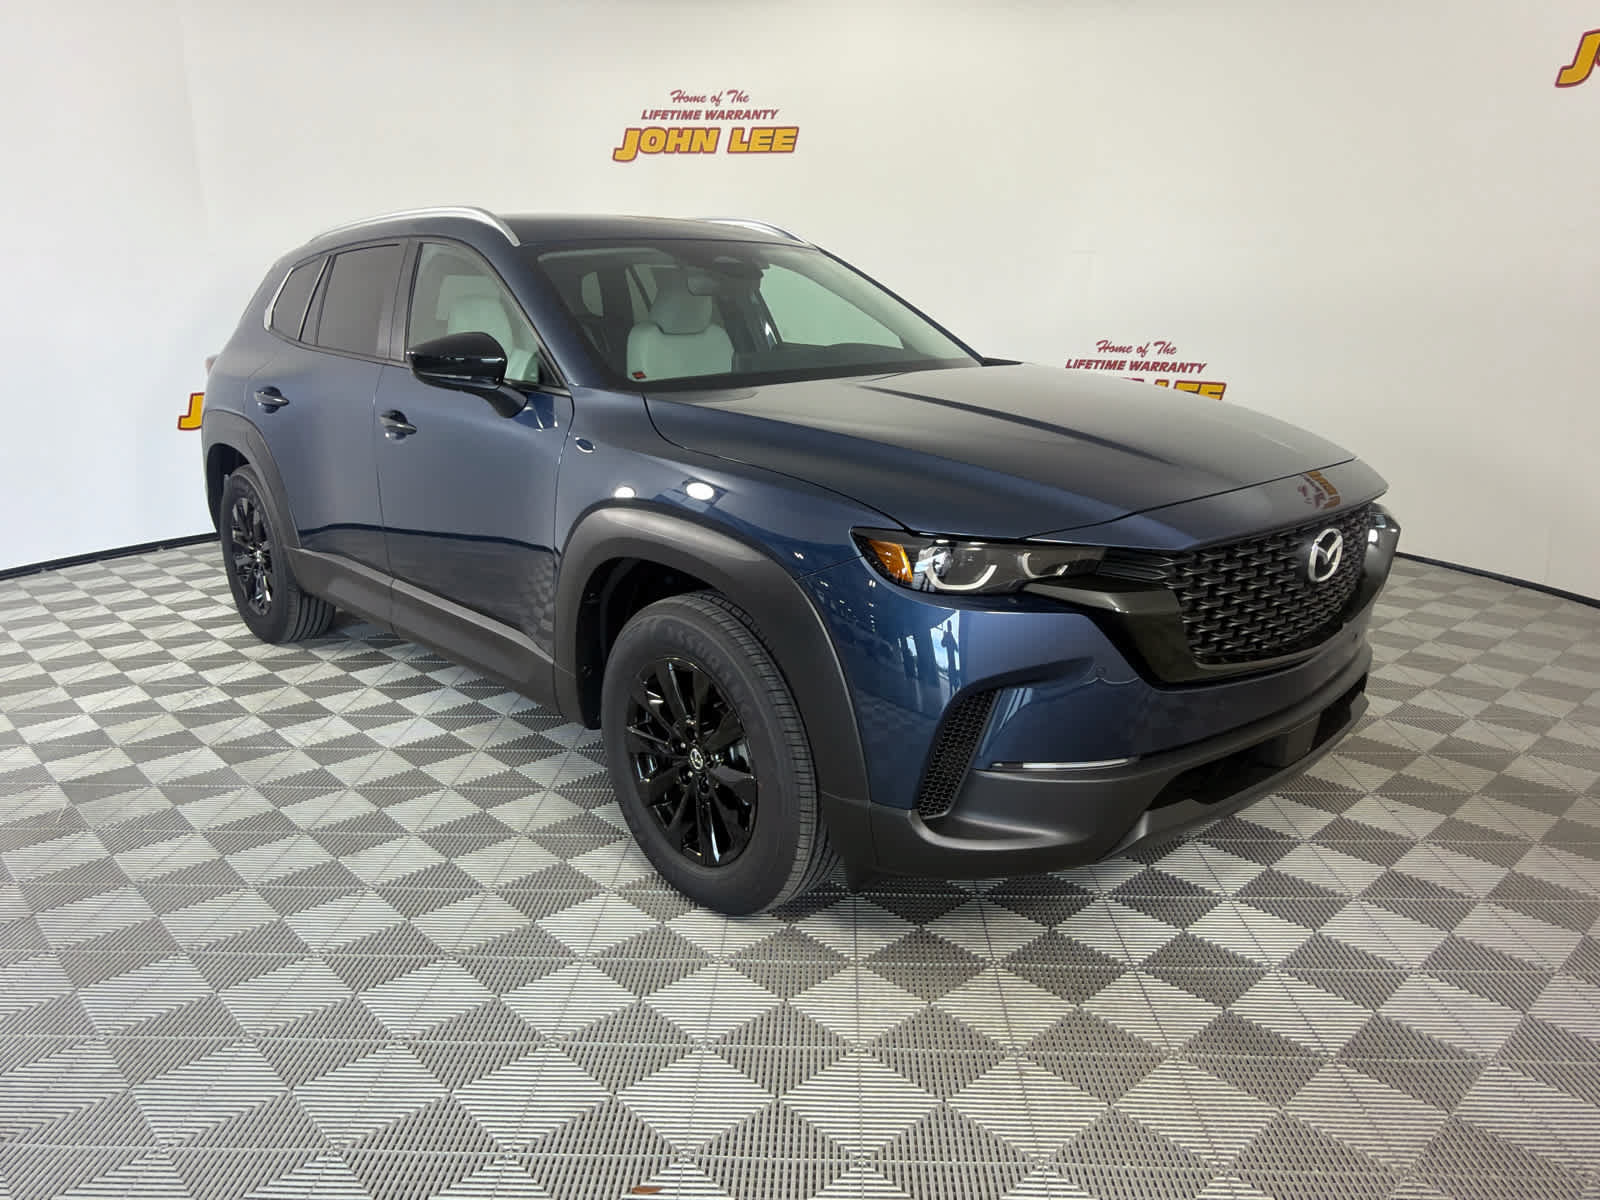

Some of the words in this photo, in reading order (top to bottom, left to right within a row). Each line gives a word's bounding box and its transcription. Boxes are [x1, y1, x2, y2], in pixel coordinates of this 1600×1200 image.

[670, 89, 706, 103] Home
[710, 92, 723, 107] of
[726, 89, 749, 103] The
[641, 109, 701, 120] LIFETIME
[705, 109, 778, 120] WARRANTY
[613, 126, 720, 162] JOHN
[727, 126, 799, 153] LEE
[1096, 339, 1132, 354] Home
[1136, 342, 1150, 358] of
[1153, 340, 1176, 355] The
[1065, 358, 1126, 371] LIFETIME
[1129, 360, 1206, 374] WARRANTY
